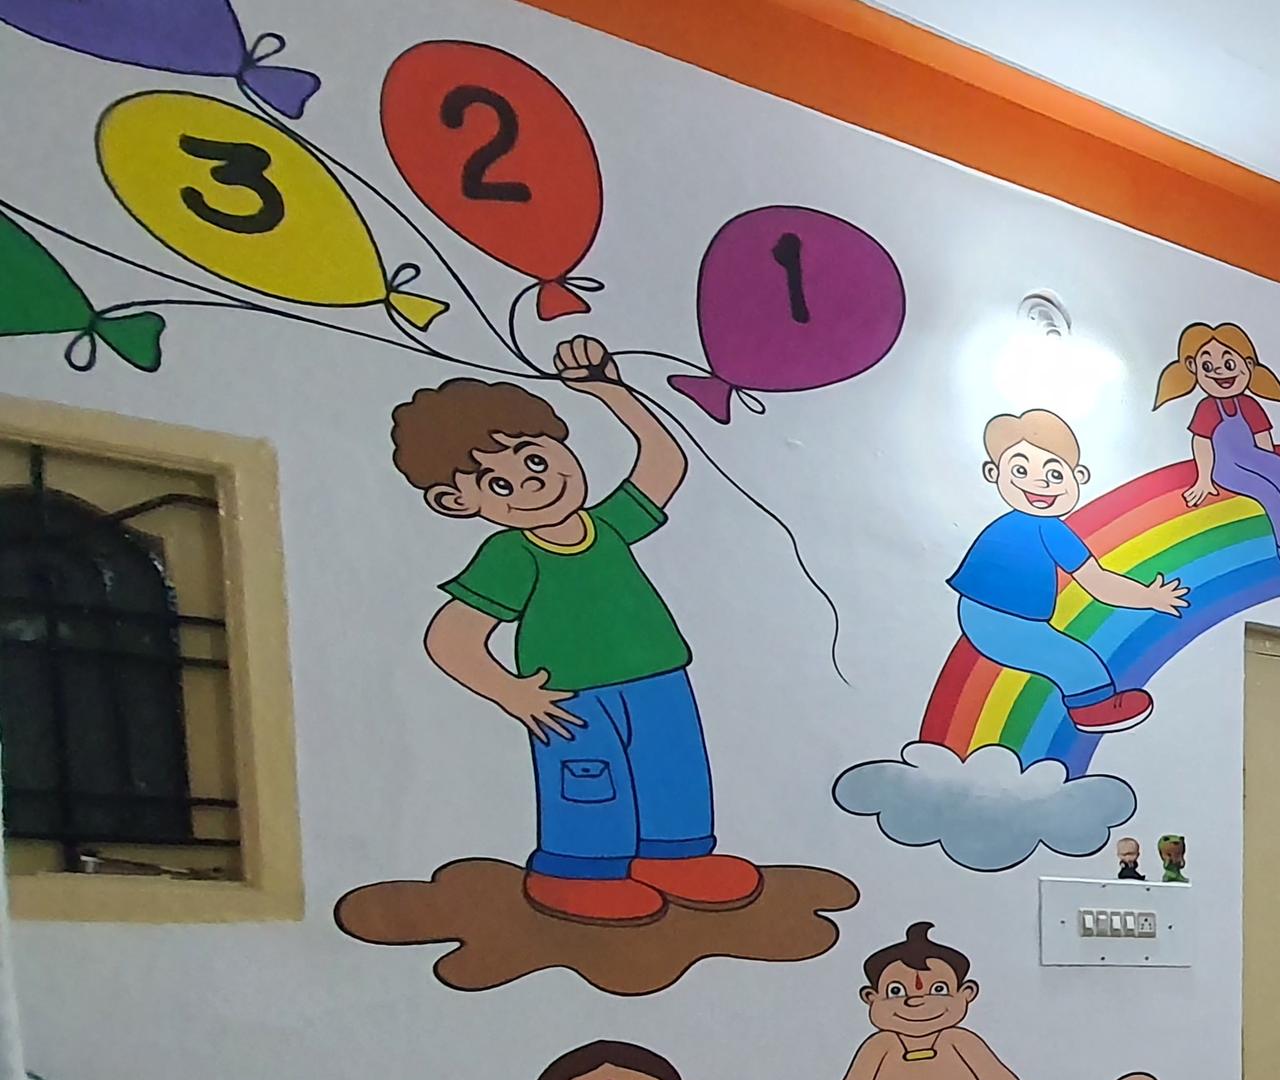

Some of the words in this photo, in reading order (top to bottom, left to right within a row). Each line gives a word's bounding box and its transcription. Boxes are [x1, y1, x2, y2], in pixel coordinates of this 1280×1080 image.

[180, 134, 285, 234] 3
[441, 86, 532, 203] 2
[771, 232, 811, 324] 1
